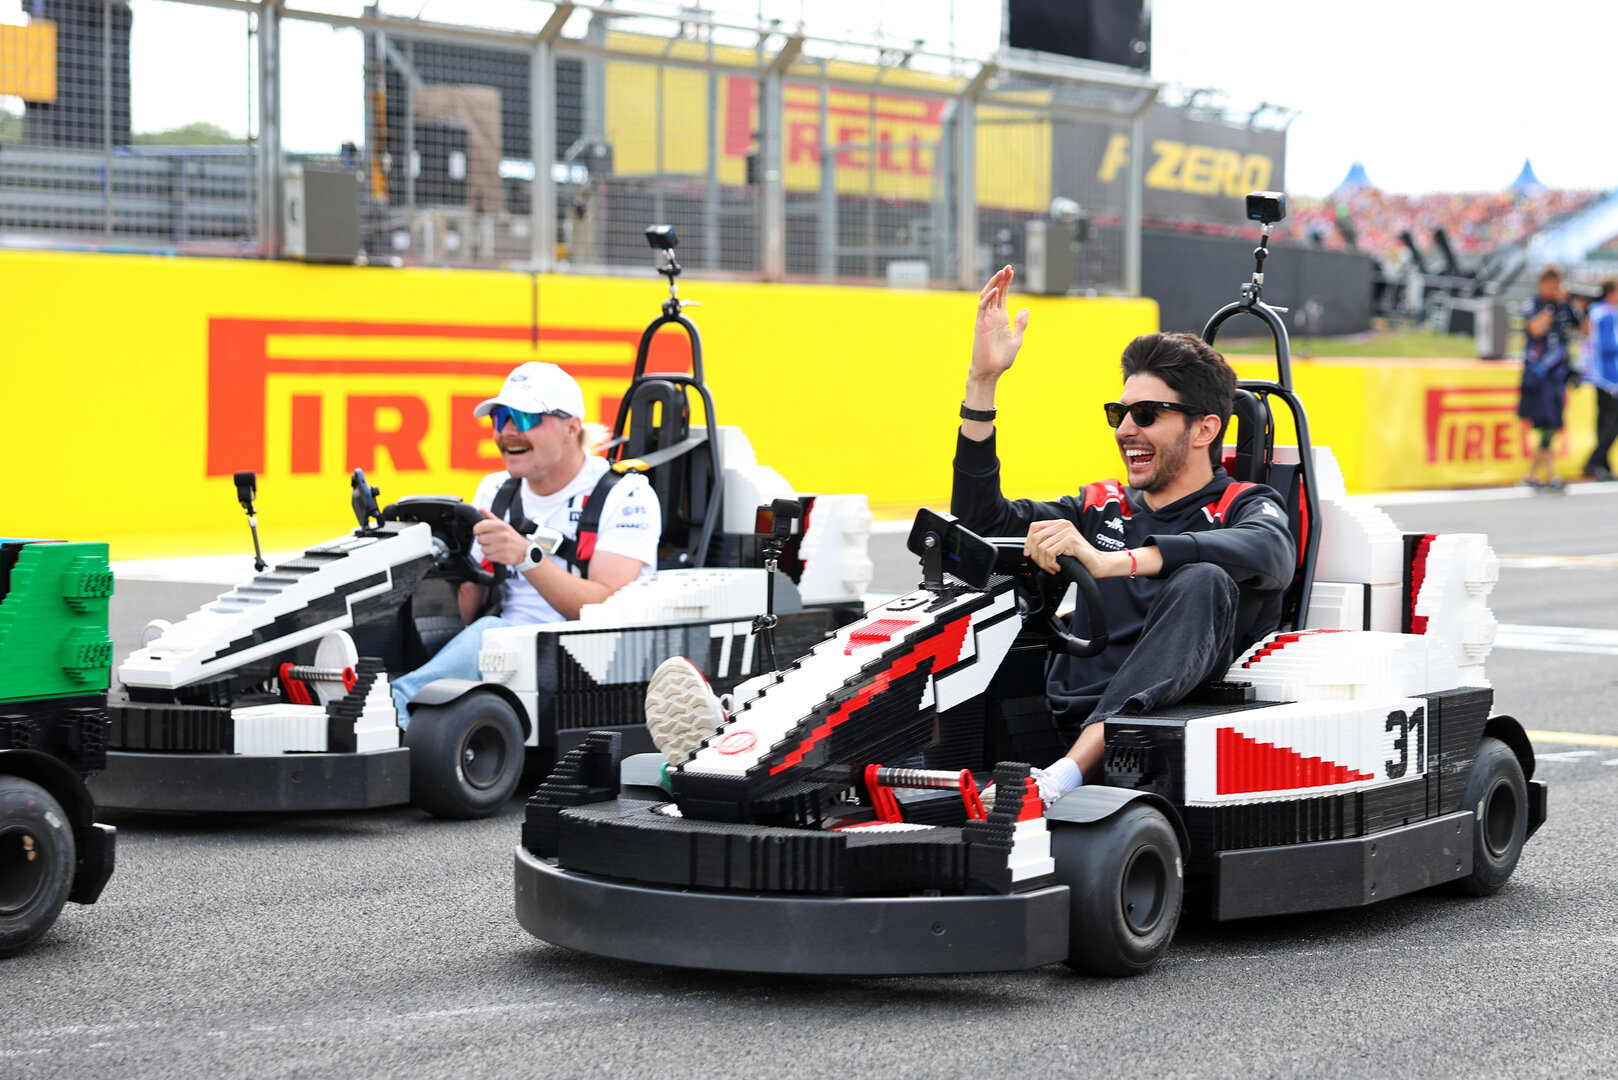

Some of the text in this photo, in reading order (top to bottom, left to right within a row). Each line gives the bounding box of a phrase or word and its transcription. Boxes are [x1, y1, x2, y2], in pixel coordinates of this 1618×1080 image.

[725, 73, 947, 176] PRELL
[1144, 138, 1273, 200] ZERO
[206, 317, 692, 477] PIRE
[709, 620, 758, 678] 77
[1385, 706, 1425, 779] 31
